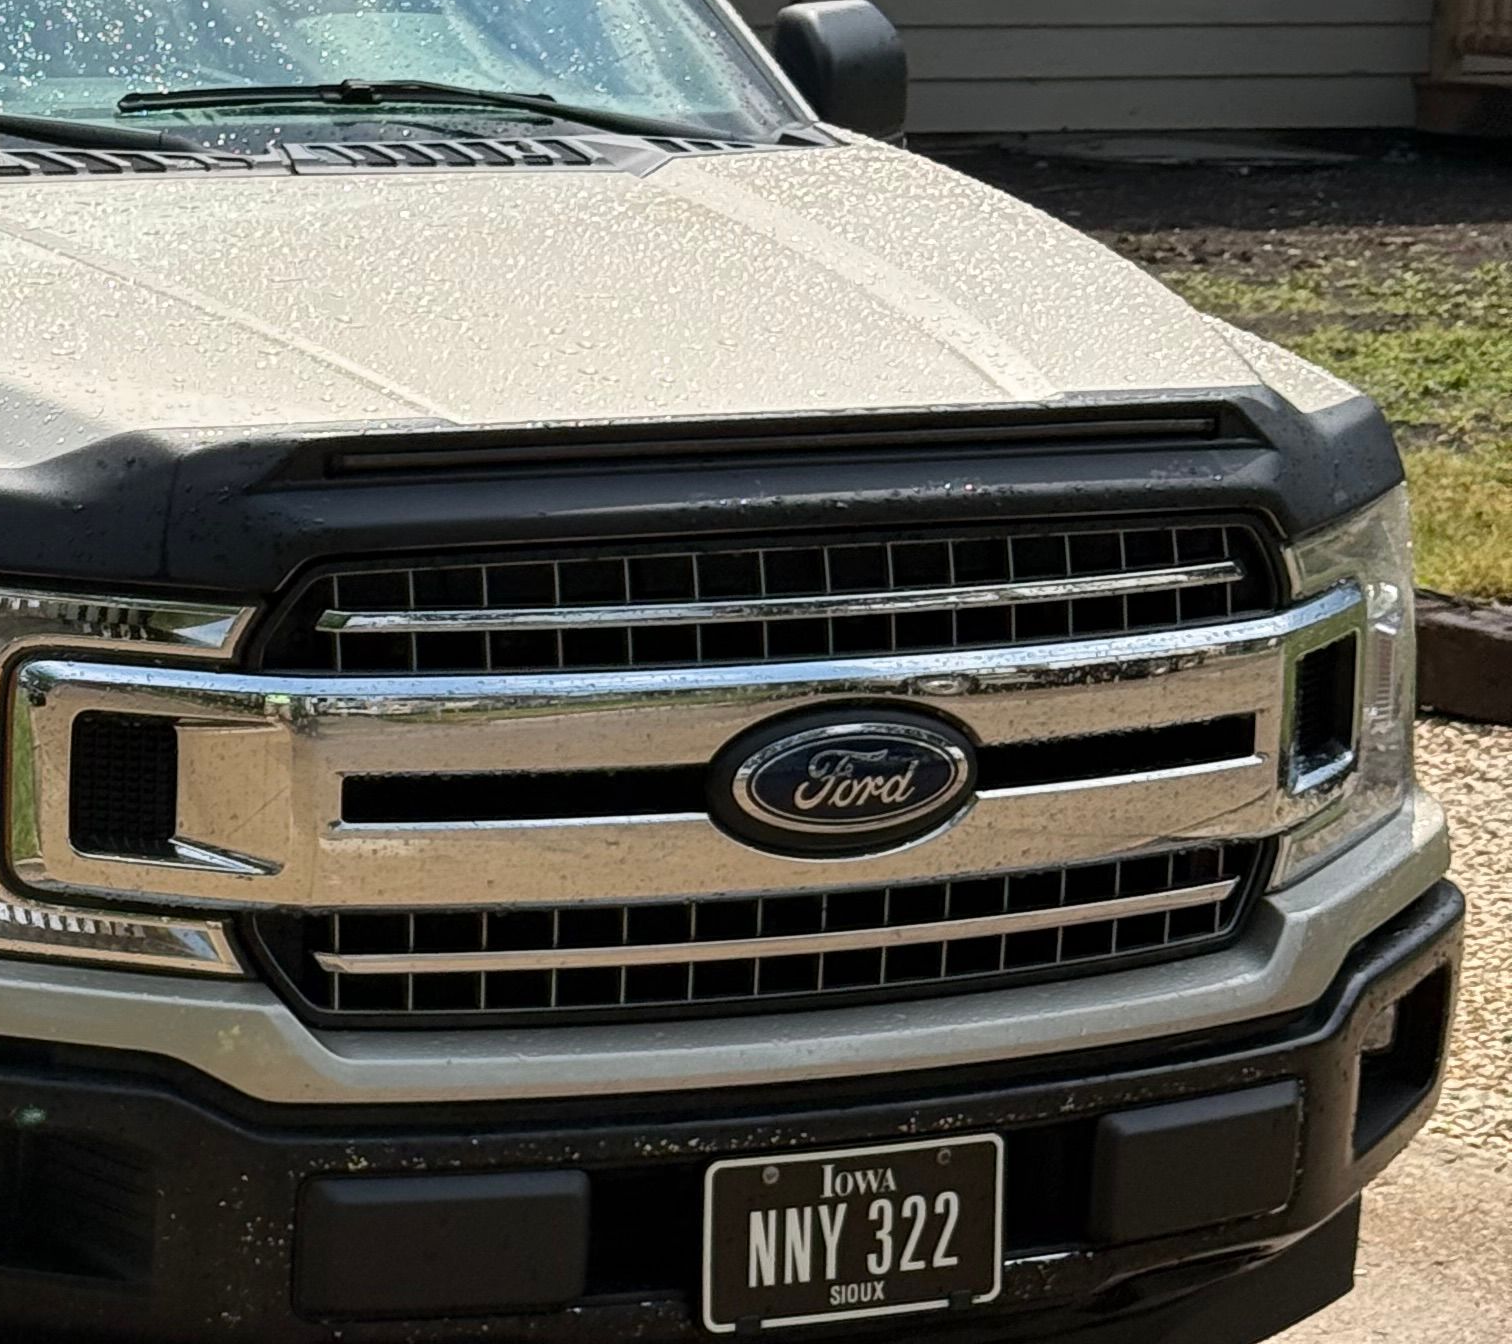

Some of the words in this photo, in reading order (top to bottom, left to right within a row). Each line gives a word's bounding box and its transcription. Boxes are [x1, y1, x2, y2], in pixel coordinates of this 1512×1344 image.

[793, 748, 920, 811] Ford
[818, 1163, 898, 1199] IOWA
[748, 1202, 849, 1289] NNY
[865, 1190, 960, 1277] 322
[829, 1280, 886, 1307] SIOUX
